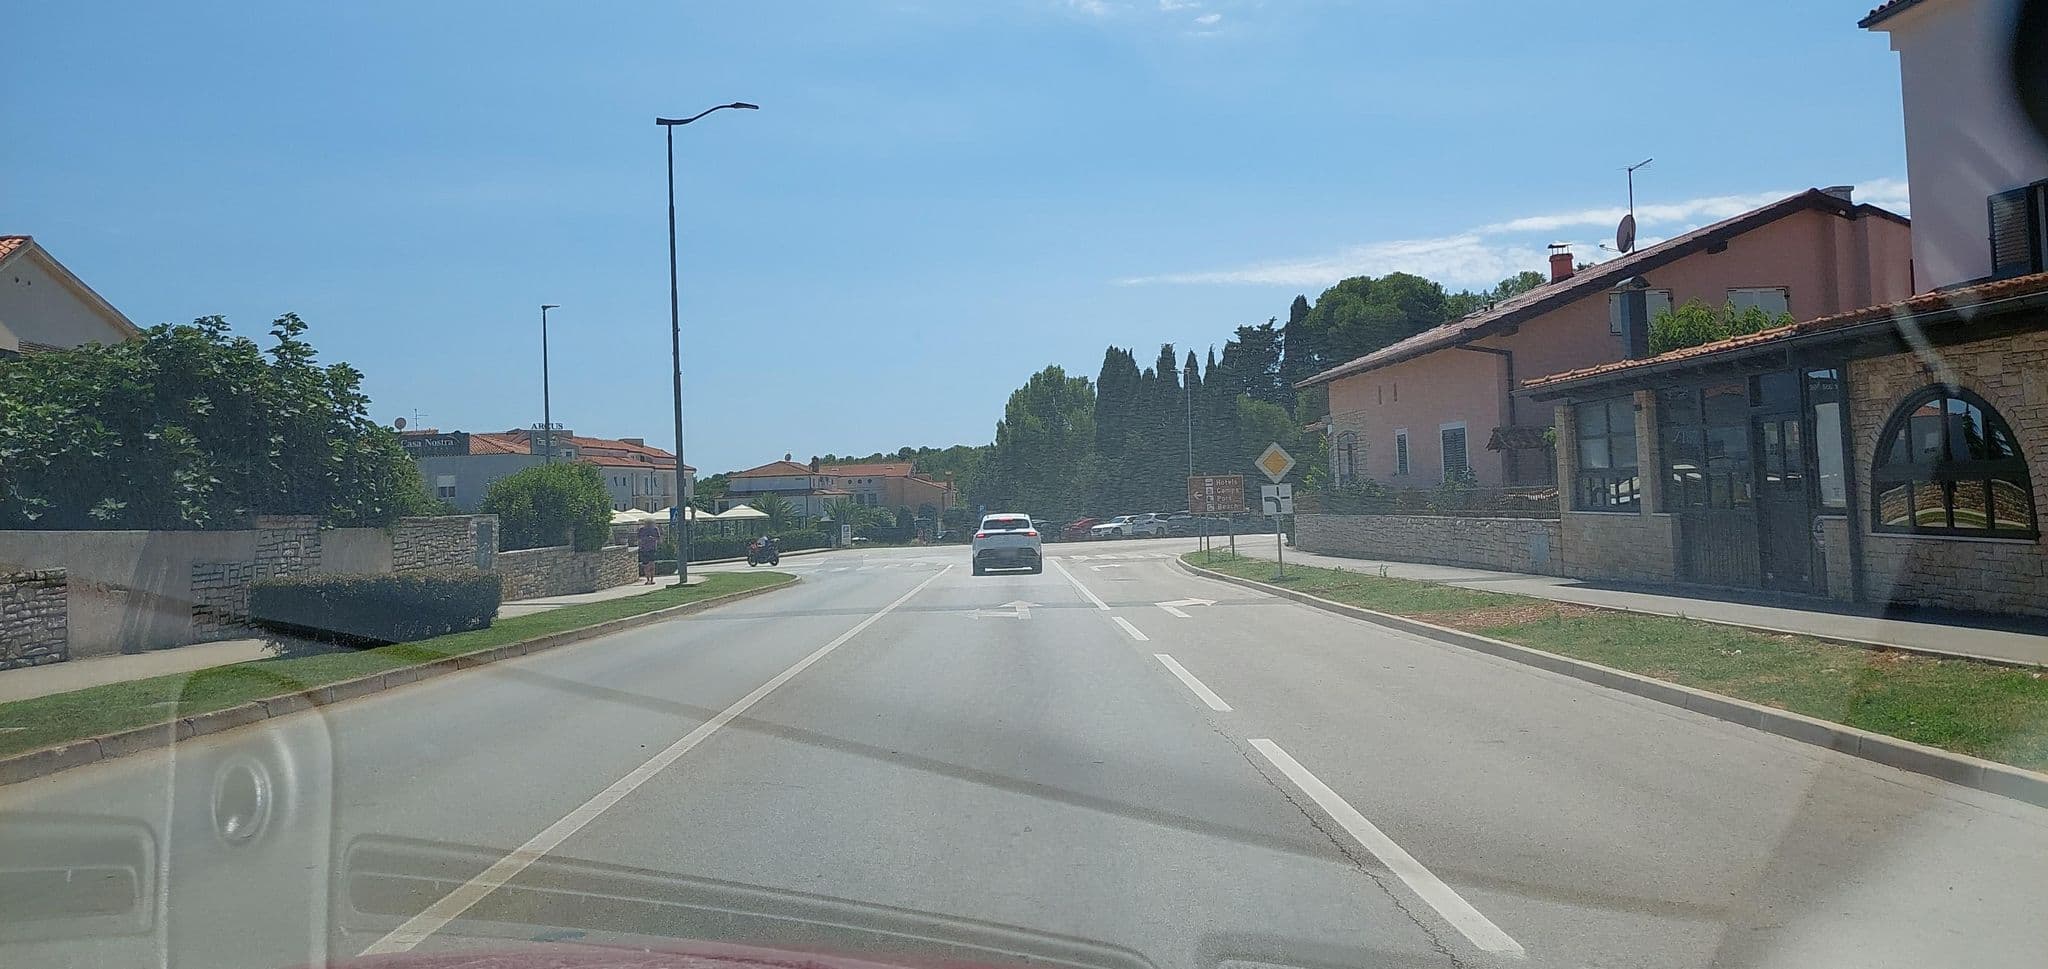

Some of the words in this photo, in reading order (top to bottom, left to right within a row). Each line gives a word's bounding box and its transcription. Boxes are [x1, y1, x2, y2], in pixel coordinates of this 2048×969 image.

[531, 422, 564, 430] ARUS
[401, 439, 422, 448] Casa
[425, 439, 454, 447] Nostra
